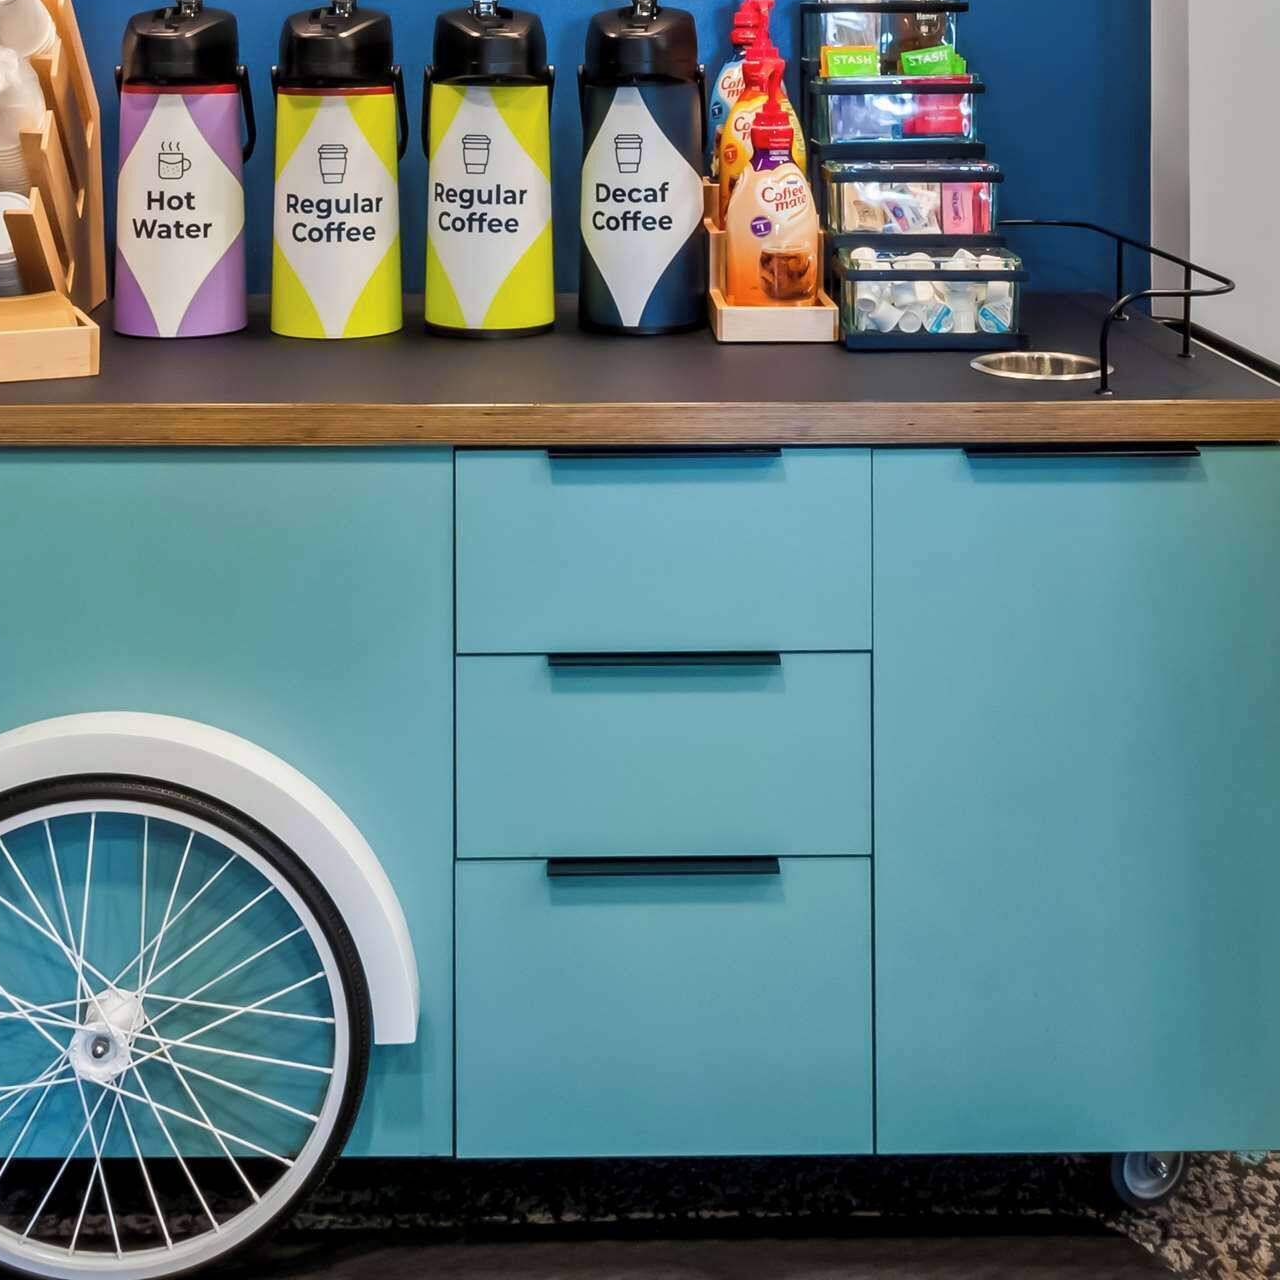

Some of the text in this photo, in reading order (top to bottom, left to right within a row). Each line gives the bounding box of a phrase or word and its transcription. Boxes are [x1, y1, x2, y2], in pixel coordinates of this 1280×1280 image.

[832, 54, 873, 66] STASH
[909, 48, 949, 68] STASH
[146, 190, 196, 211] Hot
[434, 182, 528, 210] Regular
[595, 182, 670, 204] Decaf
[761, 185, 804, 204] Coffee
[775, 193, 807, 213] mate
[286, 193, 383, 220] Regular
[132, 218, 213, 240] Water
[291, 221, 376, 243] Coffee
[438, 211, 519, 234] Coffee
[592, 210, 673, 232] Coffee
